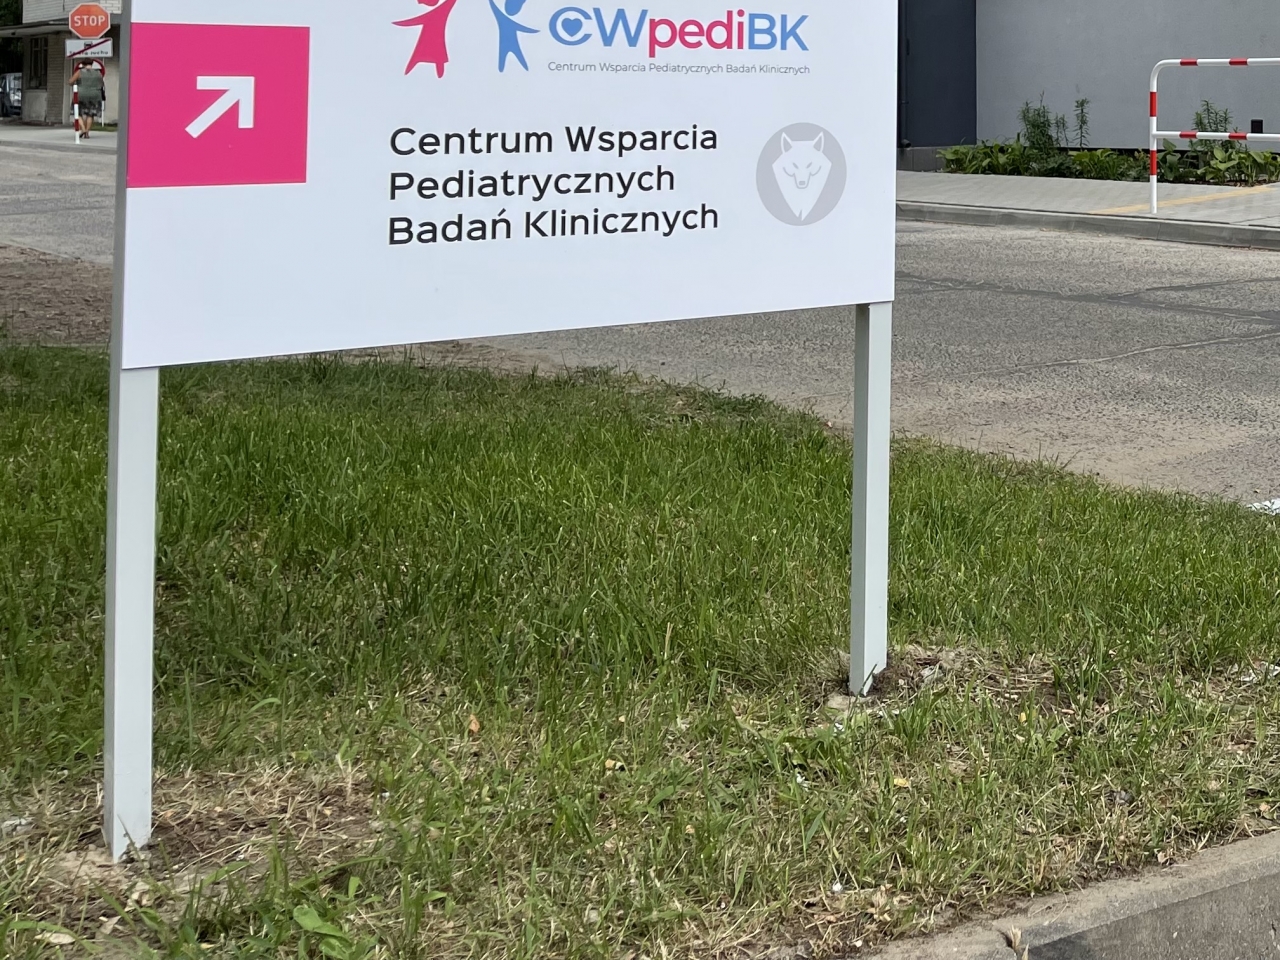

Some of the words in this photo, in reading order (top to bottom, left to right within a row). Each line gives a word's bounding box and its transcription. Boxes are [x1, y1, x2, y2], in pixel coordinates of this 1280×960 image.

[74, 15, 105, 27] STOP
[549, 7, 809, 58] CWpediBK
[548, 62, 596, 72] Centrum
[599, 62, 645, 74] Wsparcia
[649, 62, 723, 75] Pediatrycznych
[726, 63, 756, 74] Badań
[759, 65, 810, 75] Klinicznych
[390, 127, 553, 156] Centrum
[565, 124, 717, 158] Wsparcia
[390, 165, 675, 202] Pediatrycznych
[388, 208, 511, 246] Badań
[525, 203, 718, 238] Klinicznych
